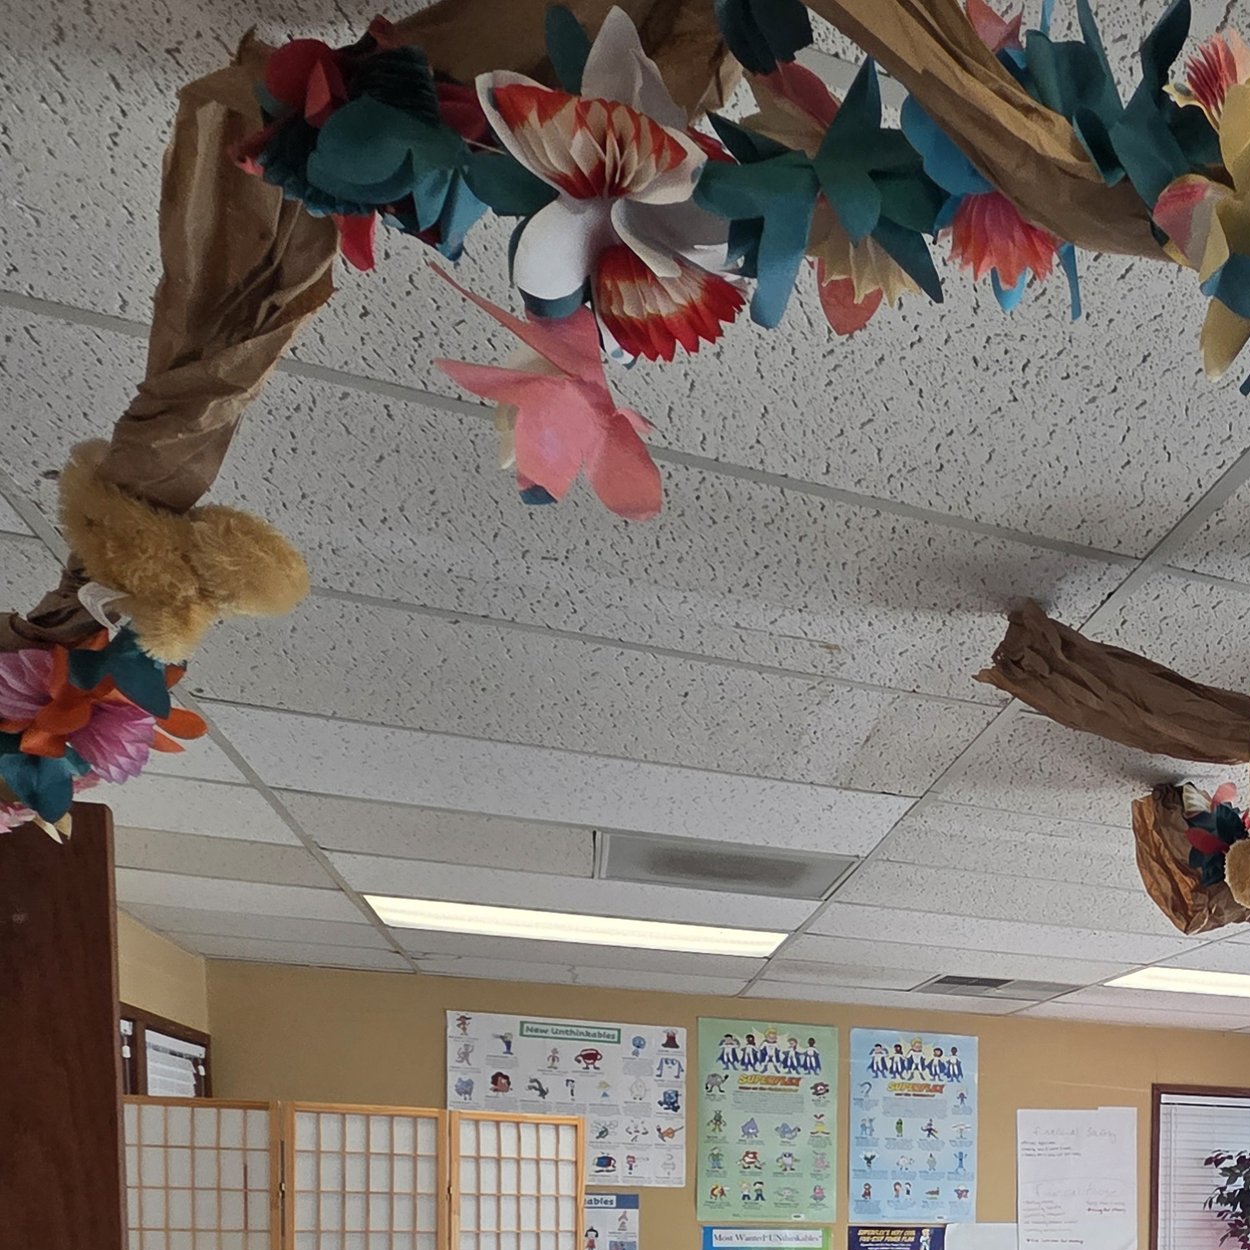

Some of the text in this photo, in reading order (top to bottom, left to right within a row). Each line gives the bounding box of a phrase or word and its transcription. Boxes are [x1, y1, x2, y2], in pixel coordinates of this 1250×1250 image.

[525, 1024, 617, 1041] New Unthinkables
[737, 1074, 802, 1087] SUPERFLEX
[886, 1081, 946, 1095] SUPERFLEX
[583, 1197, 615, 1207] ables
[713, 1233, 734, 1242] Most
